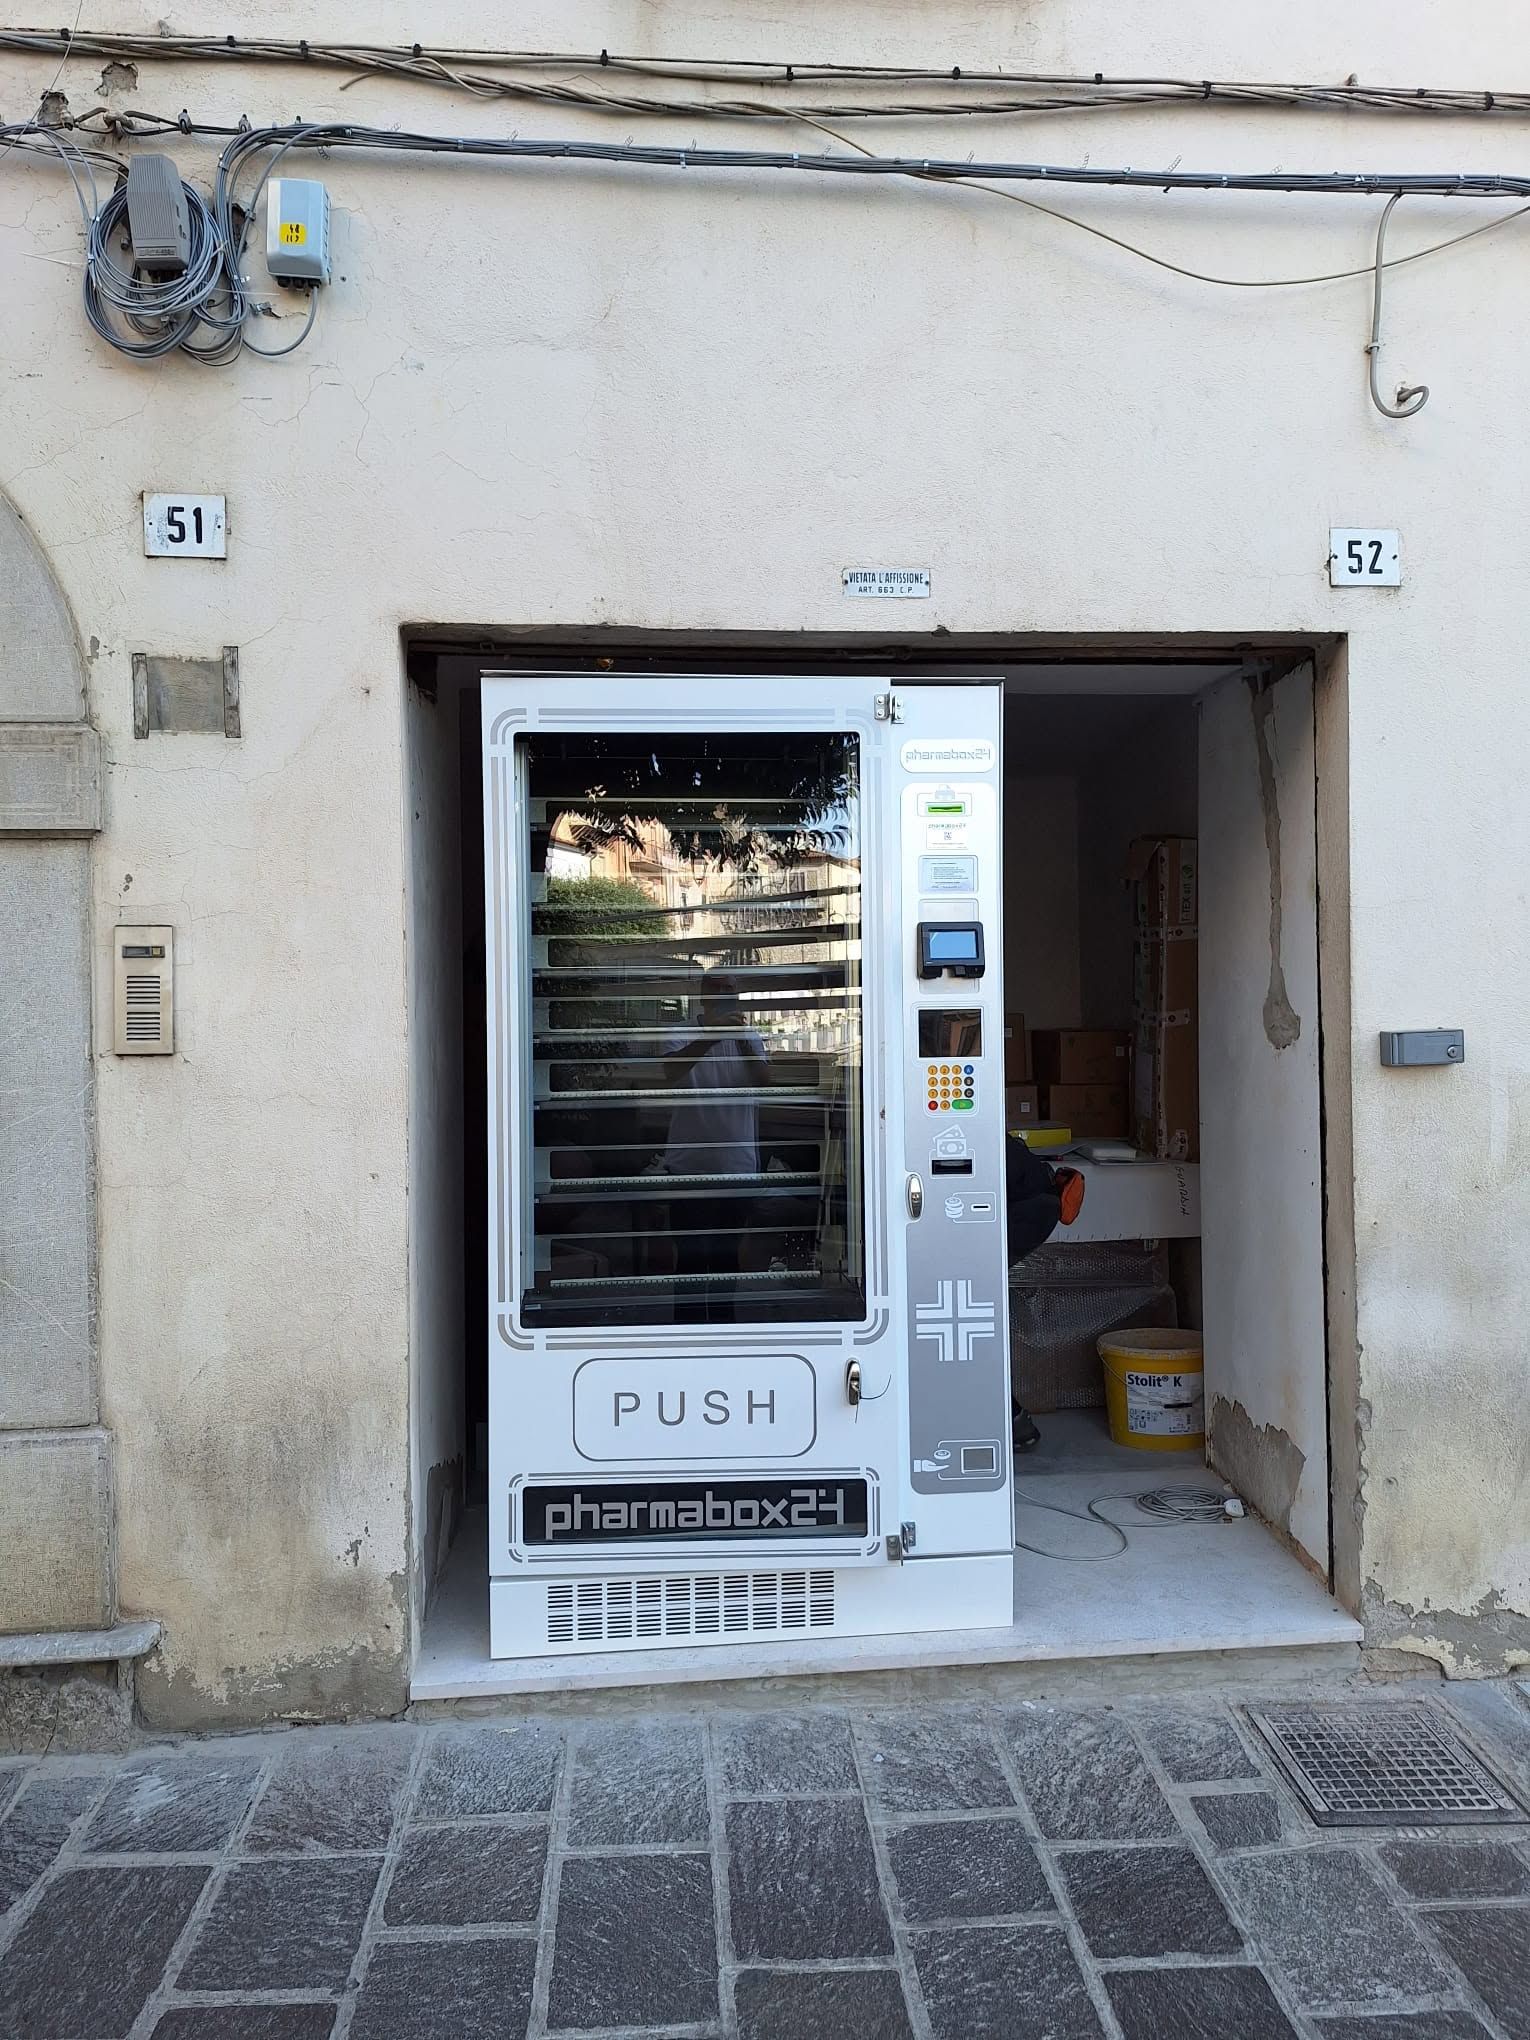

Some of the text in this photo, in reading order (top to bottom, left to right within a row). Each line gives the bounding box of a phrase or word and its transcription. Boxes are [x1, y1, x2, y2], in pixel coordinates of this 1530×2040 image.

[167, 505, 203, 545] 51
[1347, 539, 1383, 575] 52
[848, 572, 924, 585] VIETATA L'AFFISSIONE
[858, 586, 874, 594] ART.
[877, 586, 894, 594] 663
[905, 748, 991, 764] pharmabox24
[1173, 1375, 1182, 1387] K
[613, 1389, 776, 1427] PUSH
[544, 1487, 844, 1541] pharmabox24
[1464, 1762, 1505, 1800] SALERNO
